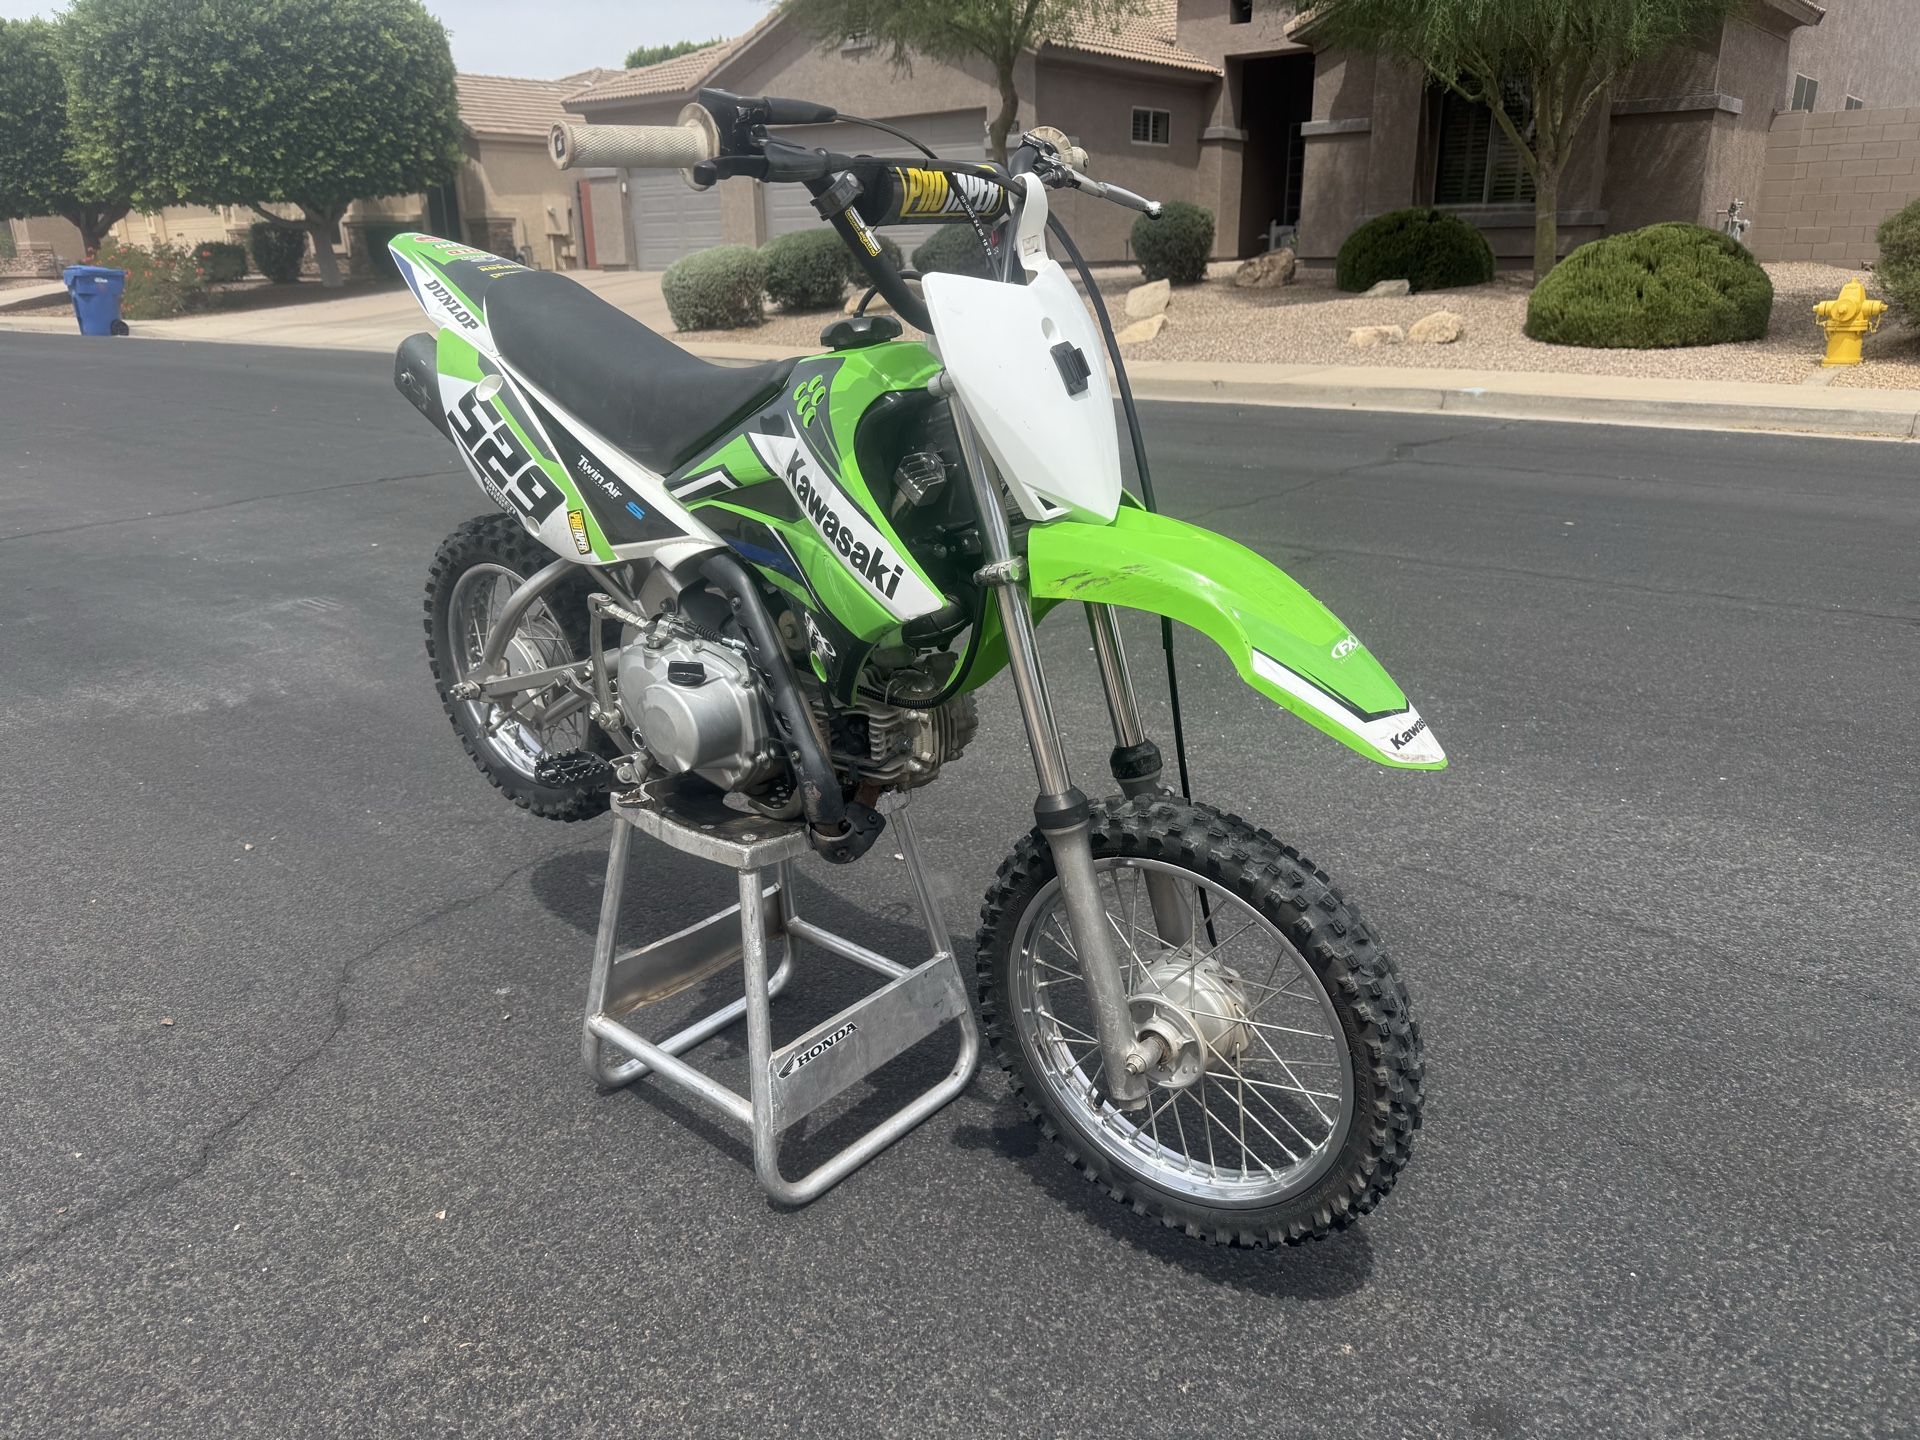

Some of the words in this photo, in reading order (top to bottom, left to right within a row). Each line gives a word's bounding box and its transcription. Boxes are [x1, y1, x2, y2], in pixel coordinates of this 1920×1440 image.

[424, 280, 479, 329] DUNLOP
[447, 383, 566, 526] 529
[577, 454, 605, 485] Twin
[602, 481, 623, 498] Air
[786, 448, 904, 600] Kawasaki
[797, 1022, 857, 1067] HONDA
